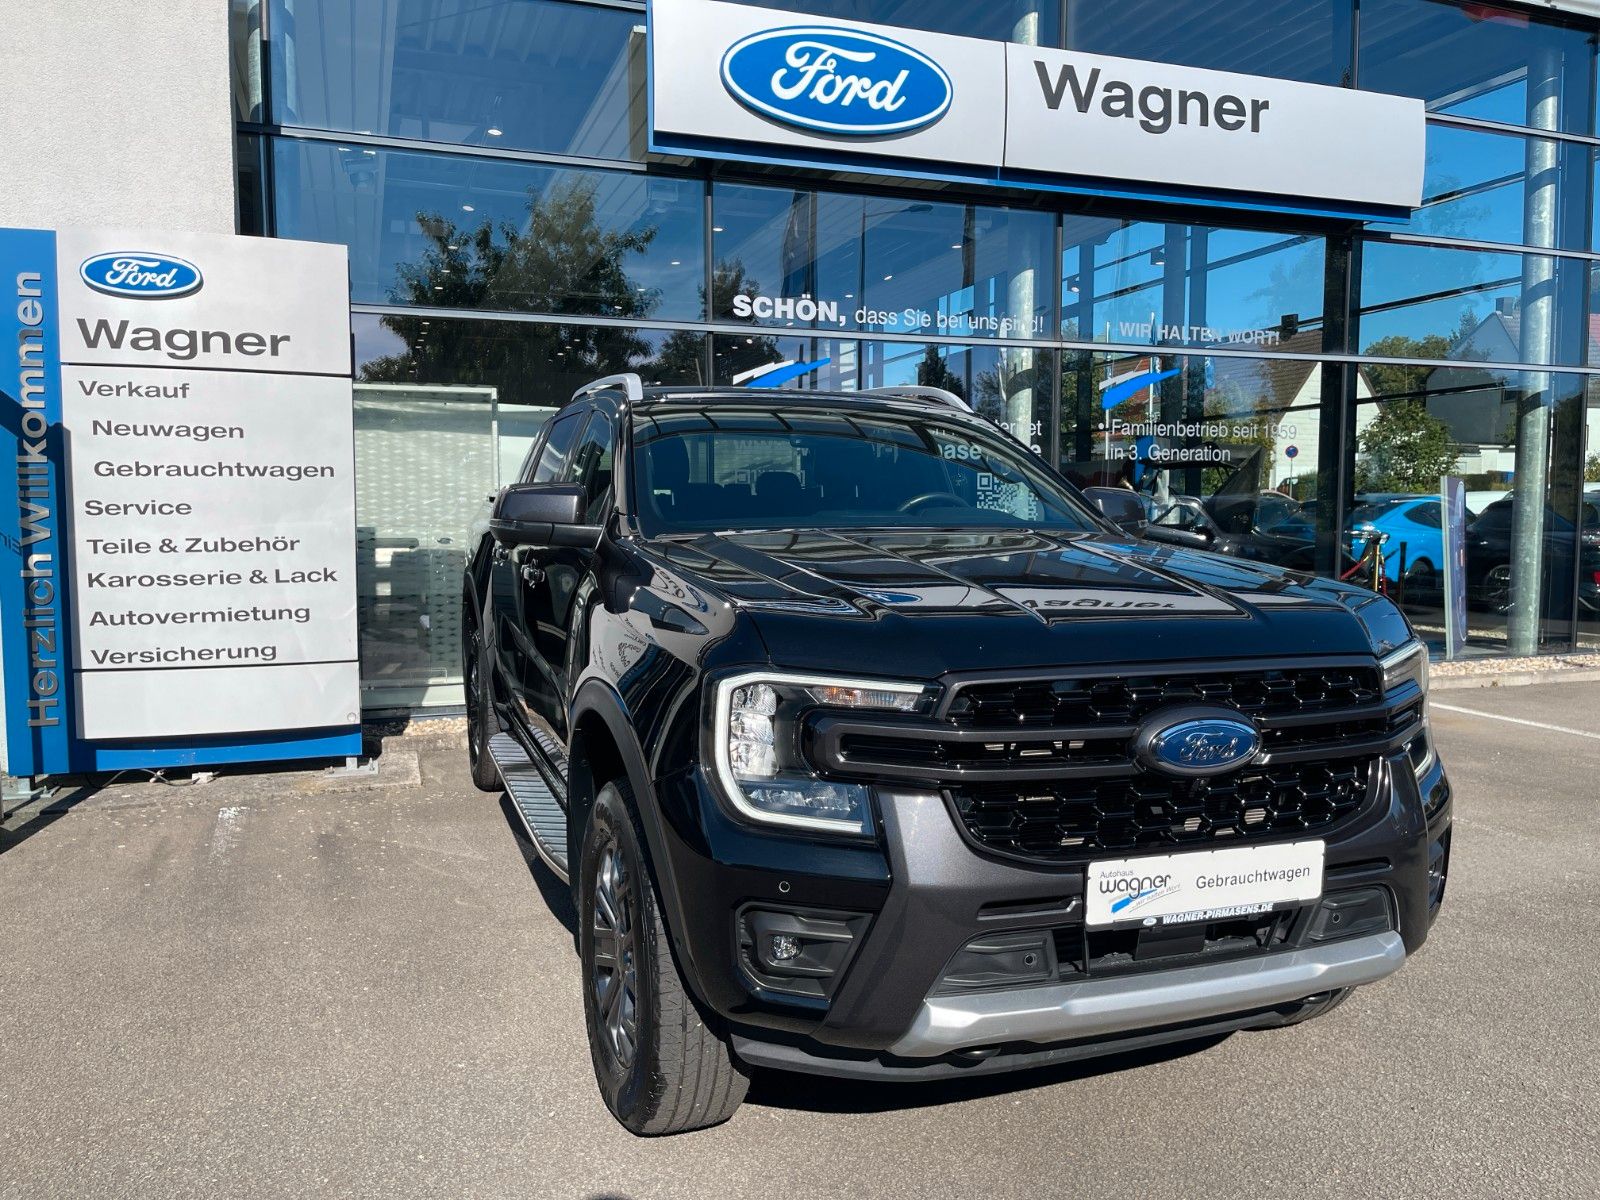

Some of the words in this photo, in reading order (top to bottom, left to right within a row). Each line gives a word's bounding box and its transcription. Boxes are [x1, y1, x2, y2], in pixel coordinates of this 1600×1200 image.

[769, 41, 910, 112] Ford
[1033, 60, 1270, 135] Wagner
[105, 258, 179, 289] Ford
[732, 293, 847, 328] SCHÖN,
[855, 305, 898, 326] dass
[903, 308, 932, 328] Sie
[937, 310, 963, 330] bei
[968, 316, 999, 331] uns
[76, 318, 291, 361] Wagner
[1119, 321, 1151, 338] WIR
[1156, 323, 1223, 342] HALTEN
[1228, 329, 1280, 346] WORT!
[78, 380, 190, 399] Verkauf
[16, 271, 51, 546] Willkommen
[92, 419, 245, 442] Neuwagen
[1112, 418, 1229, 438] Familienbetrieb
[1233, 423, 1258, 439] seit
[1263, 424, 1298, 440] 1959
[1110, 445, 1125, 461] in
[1128, 445, 1143, 461] 3.
[1148, 444, 1231, 462] Generation
[94, 460, 336, 481] Gebrauchtwagen
[85, 499, 193, 516] Service
[86, 538, 152, 556] Teile
[159, 538, 179, 554] &
[185, 536, 301, 553] Zubehör
[87, 570, 242, 589] Karosserie
[249, 569, 268, 584] &
[274, 567, 339, 584] Lack
[89, 605, 311, 627] Autovermietung
[21, 553, 59, 727] Herzlich
[90, 644, 278, 665] Versicherung
[1180, 732, 1239, 761] Ford
[1100, 869, 1134, 878] Autohaus
[1196, 866, 1311, 890] Gebrauchtwagen
[1099, 874, 1171, 899] wagner
[1162, 903, 1274, 925] WAGNER-PIRMASENS.DE
